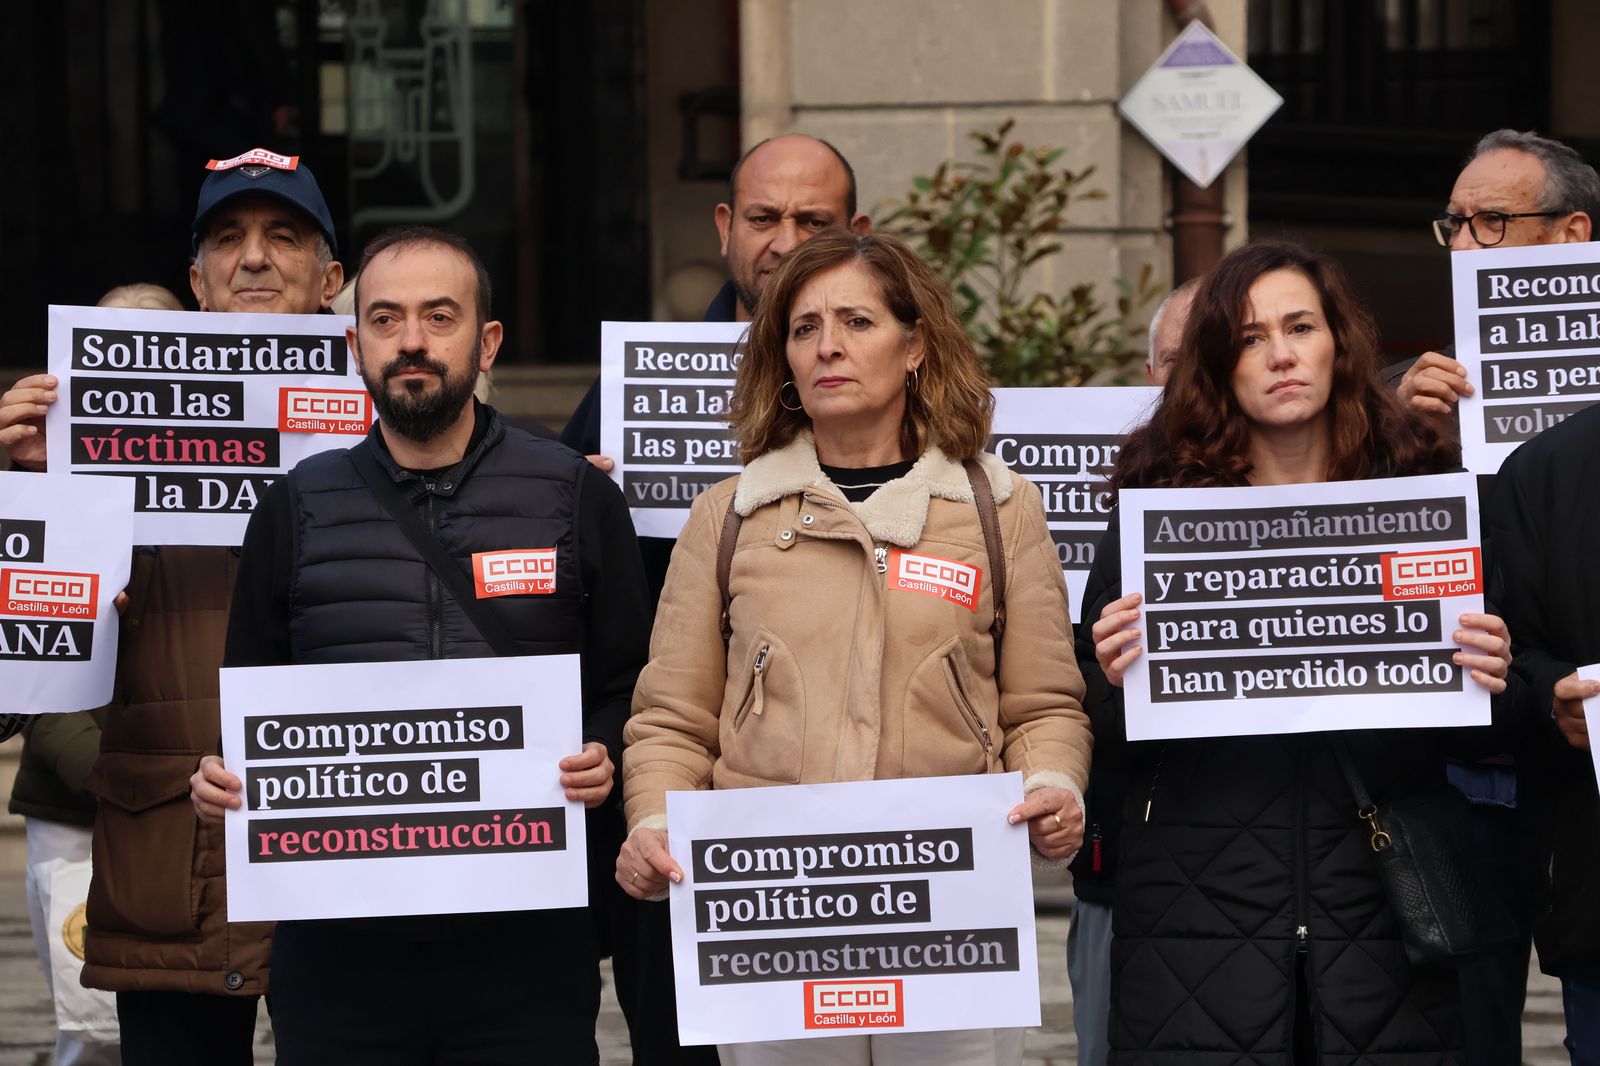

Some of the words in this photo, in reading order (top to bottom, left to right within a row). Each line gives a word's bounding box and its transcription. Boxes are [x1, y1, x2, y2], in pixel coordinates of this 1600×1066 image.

[1489, 325, 1508, 345] a
[1516, 317, 1548, 344] la
[1556, 314, 1600, 341] lab
[81, 334, 335, 372] Solidaridad
[1490, 365, 1538, 391] las
[1547, 366, 1600, 395] per
[81, 389, 159, 415] con
[170, 384, 231, 417] las
[294, 398, 358, 414] CCOO
[633, 394, 650, 414] a
[658, 389, 688, 414] la
[287, 419, 326, 430] Castilla
[329, 423, 335, 432] y
[339, 421, 364, 431] León
[1493, 408, 1573, 434] vol
[80, 428, 266, 463] víctimas
[632, 432, 675, 458] las
[684, 439, 742, 465] per
[145, 476, 185, 509] la
[198, 478, 274, 510] DA
[1153, 506, 1452, 549] Acompañamiento
[489, 558, 554, 576] CCOO
[906, 560, 970, 587] CCOO
[1154, 571, 1175, 601] y
[1184, 557, 1382, 601] reparación
[1398, 559, 1467, 579] CCOO
[15, 579, 84, 598] CCOO
[485, 581, 525, 593] Castilla
[528, 582, 535, 592] y
[898, 578, 938, 593] Castilla
[949, 588, 972, 605] León
[1393, 584, 1435, 596] Castilla
[1438, 585, 1445, 595] y
[1449, 582, 1476, 593] León
[8, 601, 49, 612] Castilla
[52, 605, 59, 615] y
[62, 604, 89, 615] León
[1157, 618, 1239, 650] para
[1248, 609, 1386, 646] quienes
[1394, 606, 1428, 634] lo
[1160, 666, 1226, 695] han
[1233, 660, 1368, 699] perdido
[1375, 657, 1453, 688] todo
[256, 711, 511, 756] Compromiso
[257, 765, 409, 809] político
[421, 763, 467, 795] de
[258, 813, 553, 856] reconstrucción
[703, 834, 960, 879] Compromiso
[706, 888, 858, 932] político
[871, 884, 917, 916] de
[709, 934, 1005, 978] reconstrucción
[820, 990, 888, 1007] CCOO
[814, 1014, 856, 1024] Castilla
[859, 1015, 865, 1026] y
[869, 1013, 896, 1023] León
